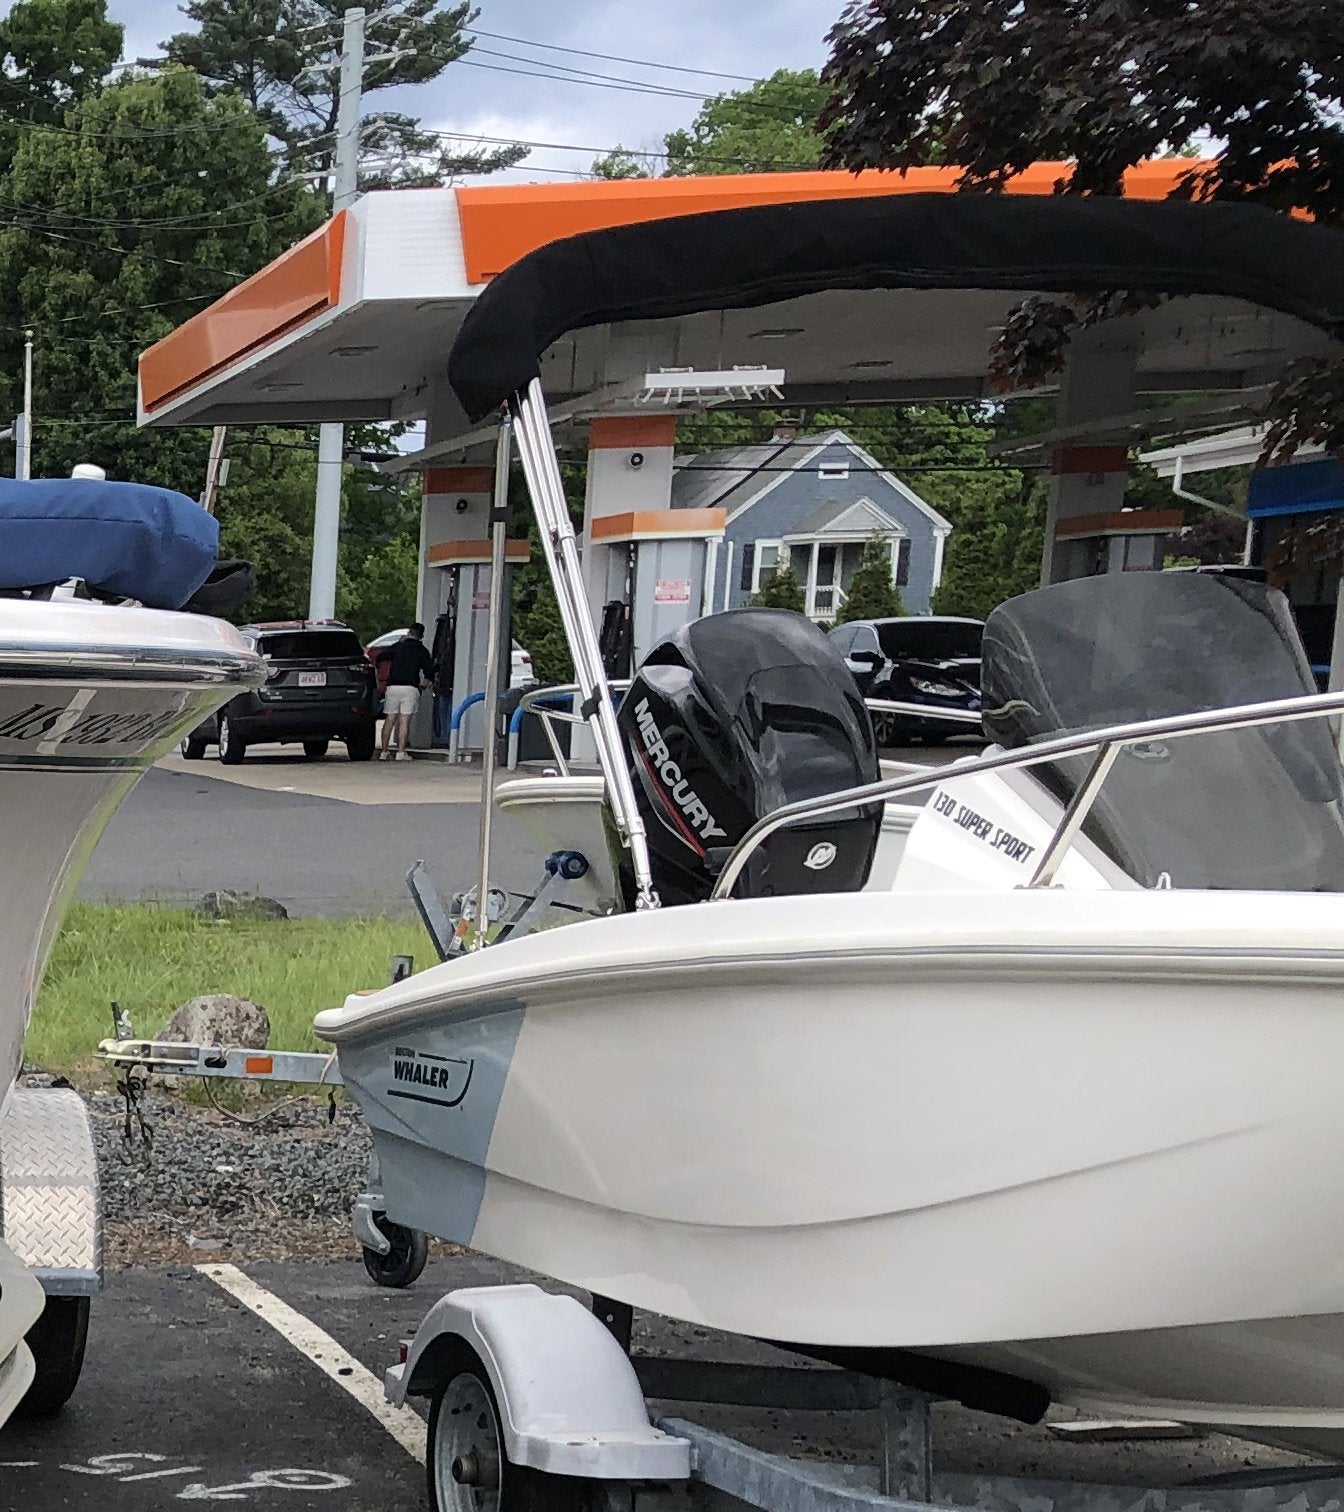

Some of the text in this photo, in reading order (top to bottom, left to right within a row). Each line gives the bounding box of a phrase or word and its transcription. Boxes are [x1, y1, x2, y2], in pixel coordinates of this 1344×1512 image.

[634, 697, 727, 840] MERCURY
[933, 791, 1036, 864] 130 SUPER SPORT
[394, 1060, 449, 1089] WHALER
